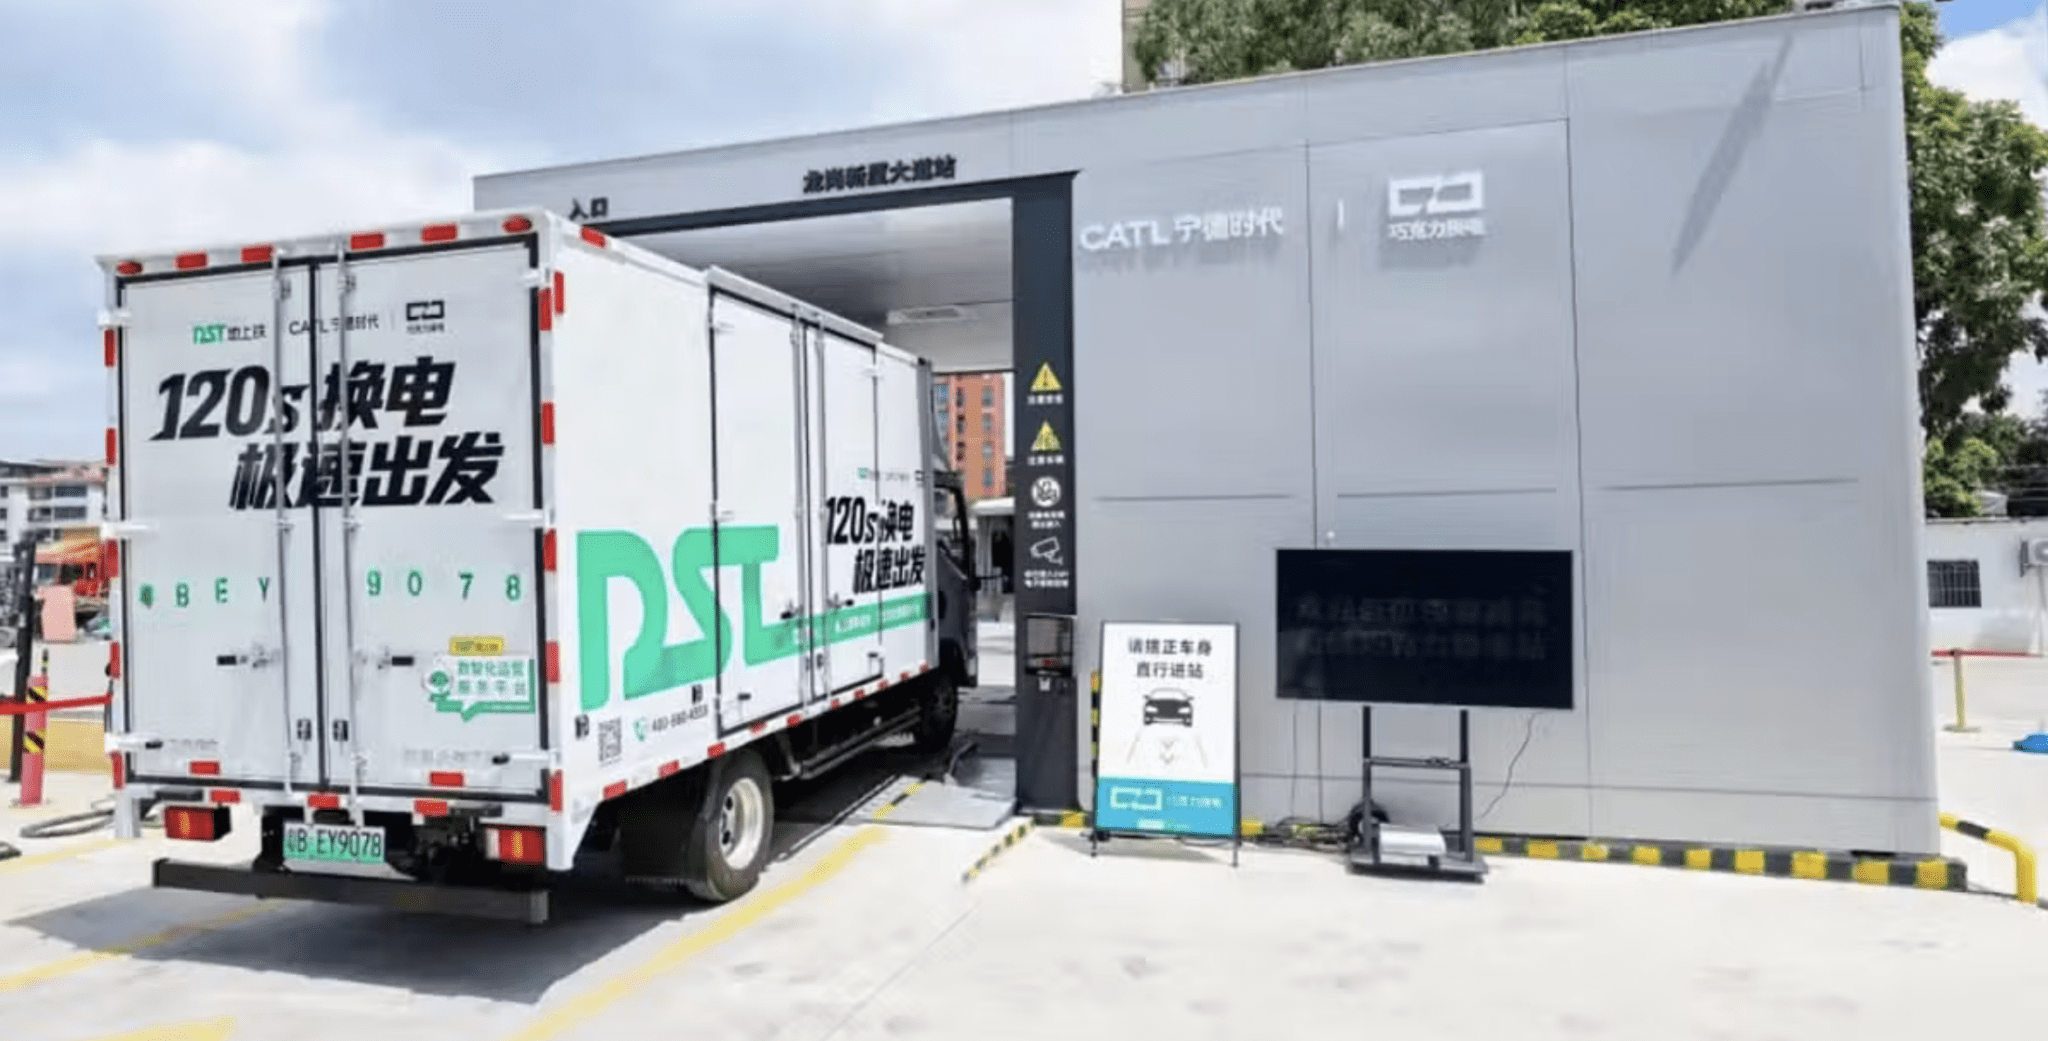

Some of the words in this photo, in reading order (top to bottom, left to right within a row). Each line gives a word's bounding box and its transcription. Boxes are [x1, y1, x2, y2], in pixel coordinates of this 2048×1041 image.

[568, 197, 608, 221] 入口
[1079, 219, 1170, 251] CATL
[149, 365, 308, 442] 120s
[318, 356, 455, 429] 换电
[229, 432, 504, 510] 极速出发
[826, 496, 878, 545] 120s
[853, 545, 926, 594] 极速出发
